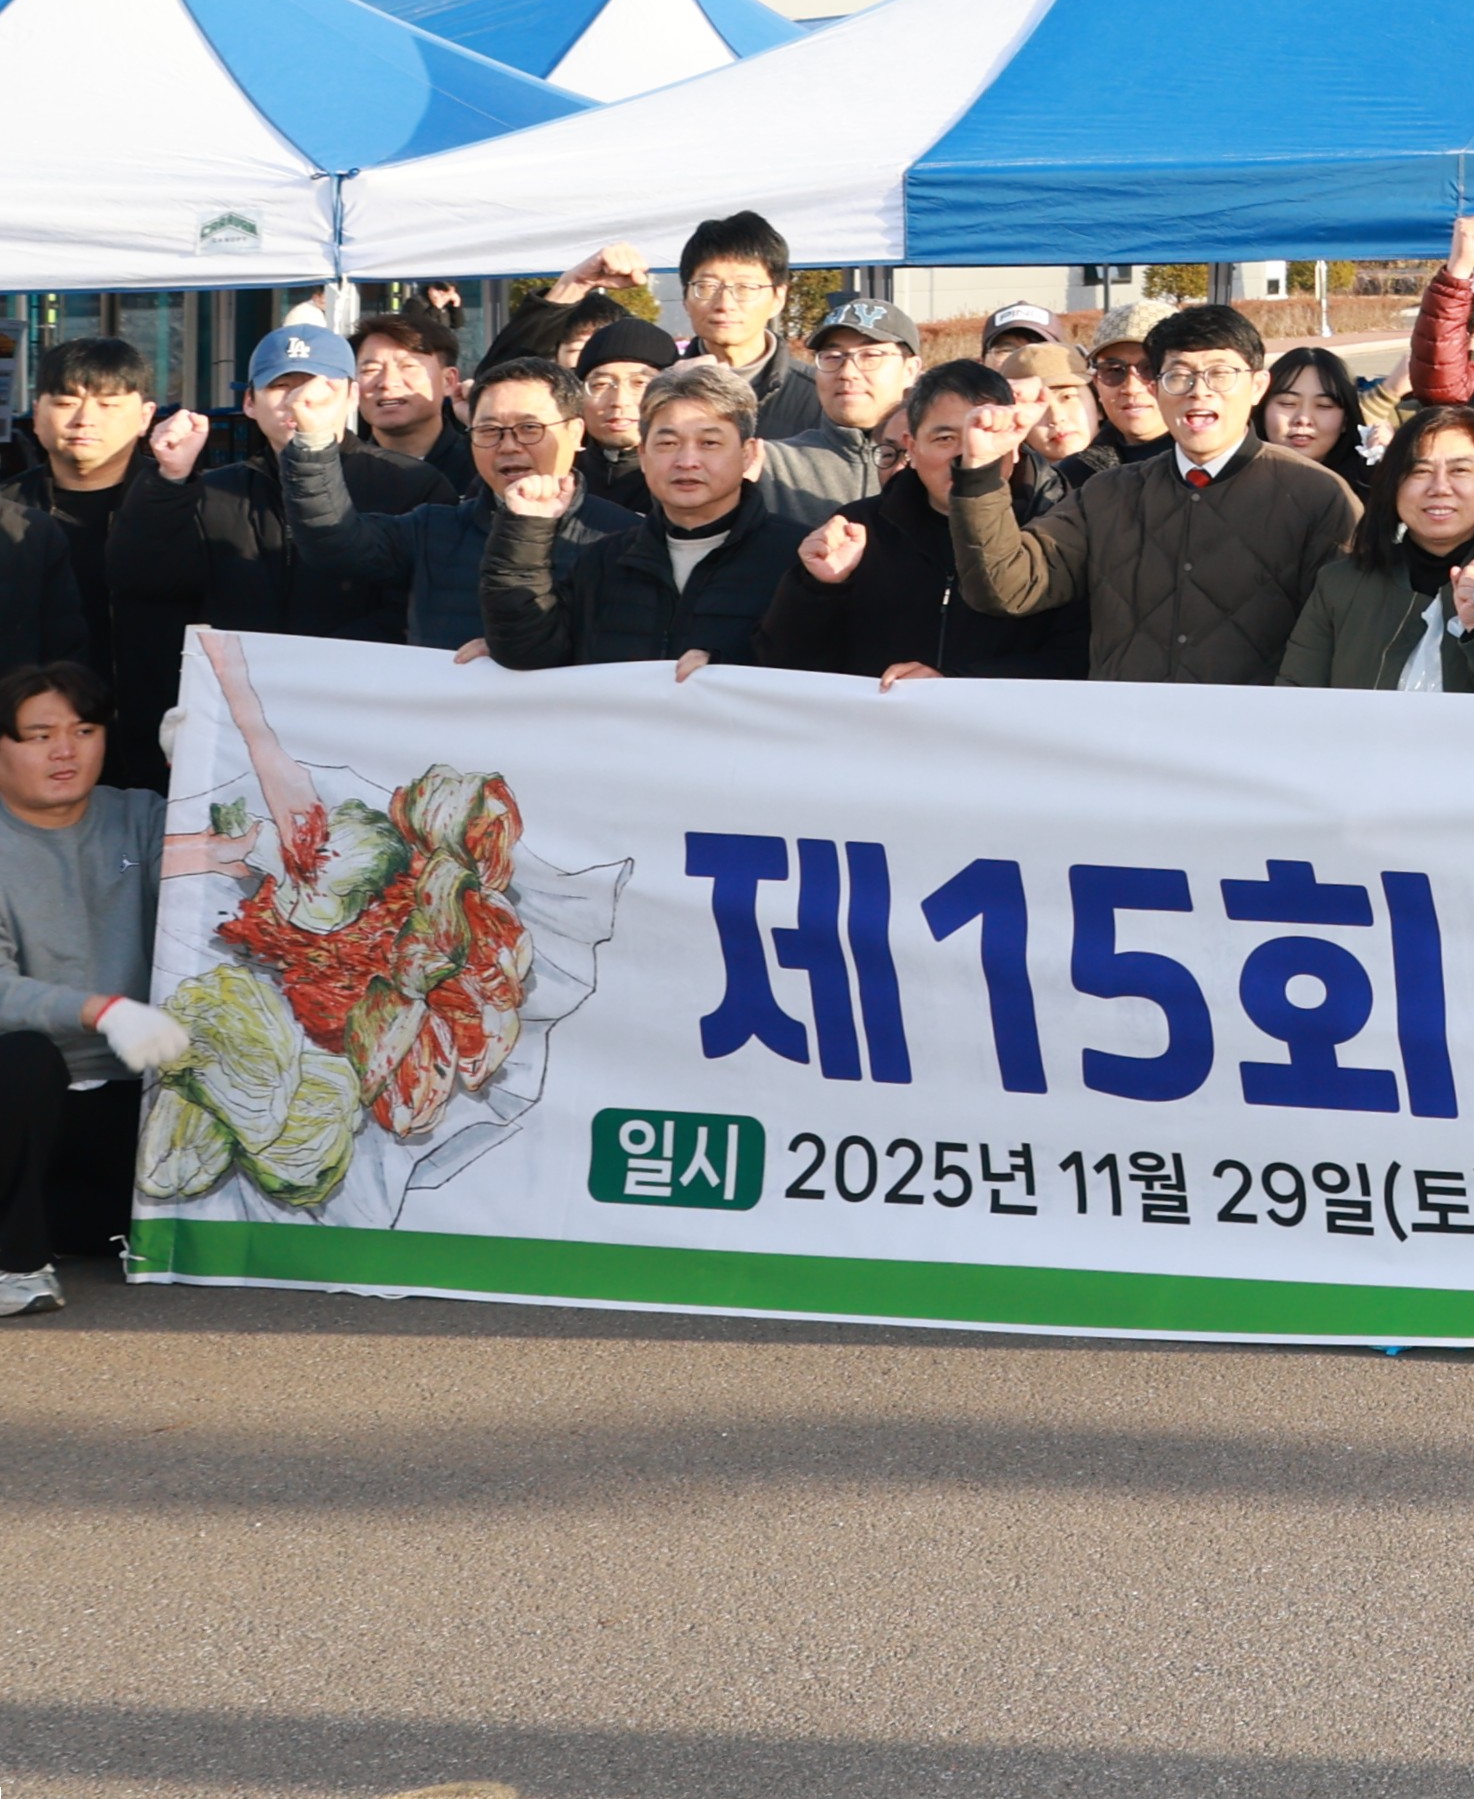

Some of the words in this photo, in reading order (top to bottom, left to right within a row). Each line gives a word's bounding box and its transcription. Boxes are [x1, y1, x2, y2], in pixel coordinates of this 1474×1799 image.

[287, 337, 310, 358] LA
[685, 832, 1458, 1119] 제15회
[620, 1121, 737, 1199] 일시
[786, 1133, 1037, 1215] 2025년
[1059, 1151, 1190, 1224] 11월
